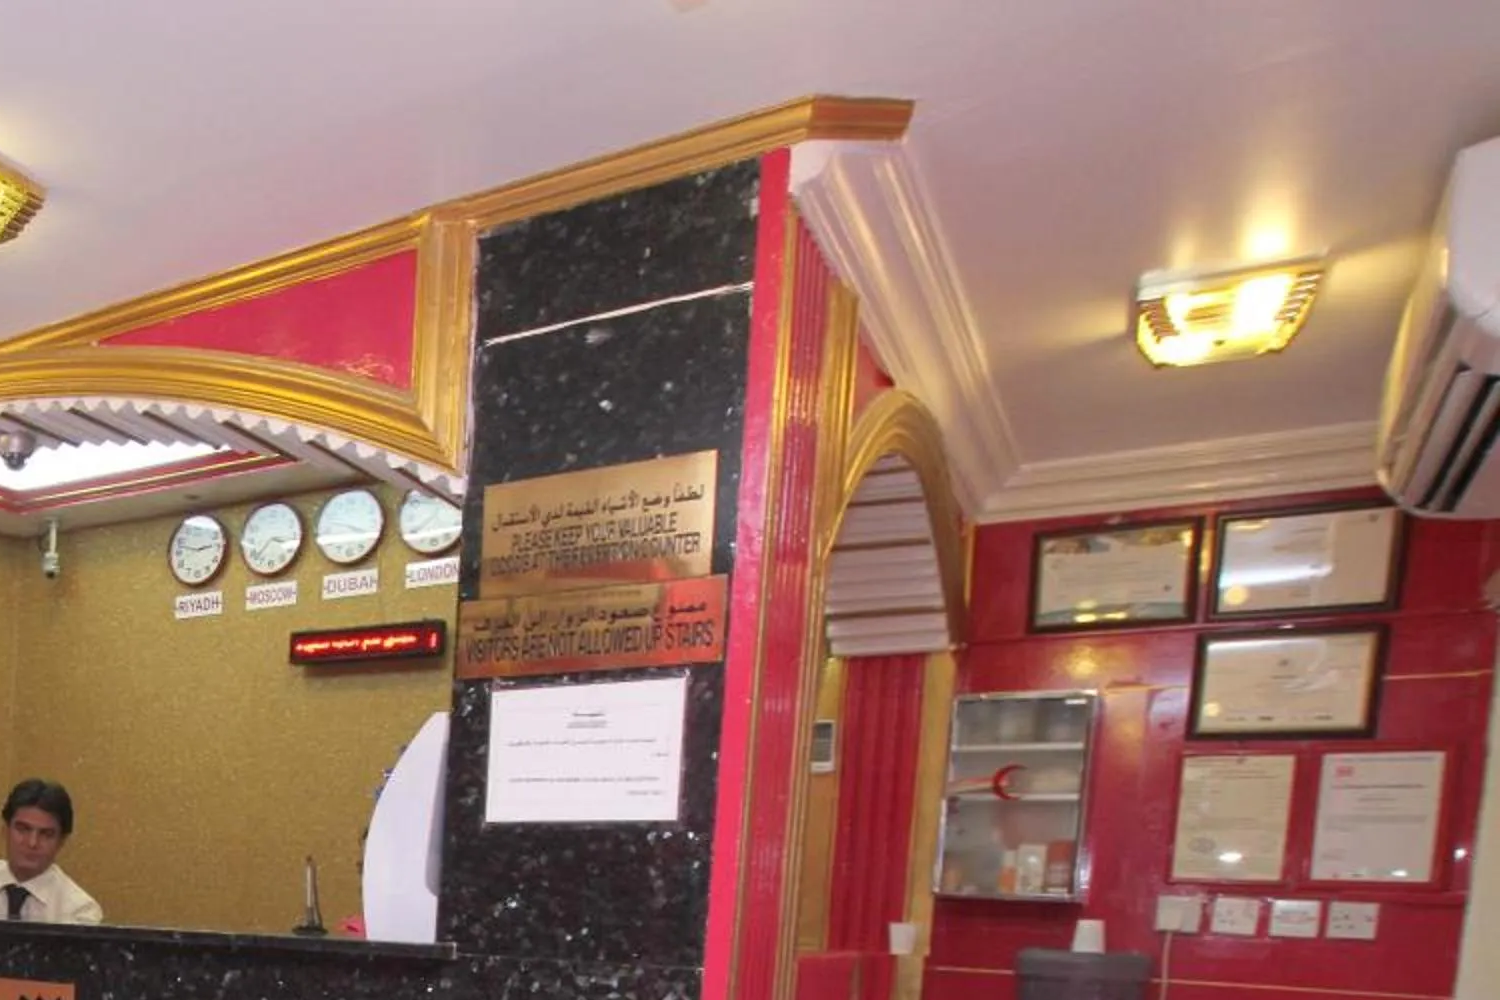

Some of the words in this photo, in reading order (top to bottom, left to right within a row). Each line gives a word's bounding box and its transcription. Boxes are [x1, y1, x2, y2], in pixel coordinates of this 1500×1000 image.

[511, 529, 553, 552] PLEASE
[554, 525, 583, 547] KEEP
[586, 519, 616, 543] YOUR
[617, 511, 679, 538] VALUABLE
[326, 575, 373, 594] DUBAI
[179, 595, 219, 613] RIYADH
[250, 586, 293, 604] MOSCOW
[466, 636, 519, 664] VISITORS
[520, 633, 548, 659] ARE
[549, 631, 577, 657] NOT
[577, 626, 644, 655] ALLOWED
[644, 624, 662, 649] UP
[665, 621, 714, 650] STAIRS
